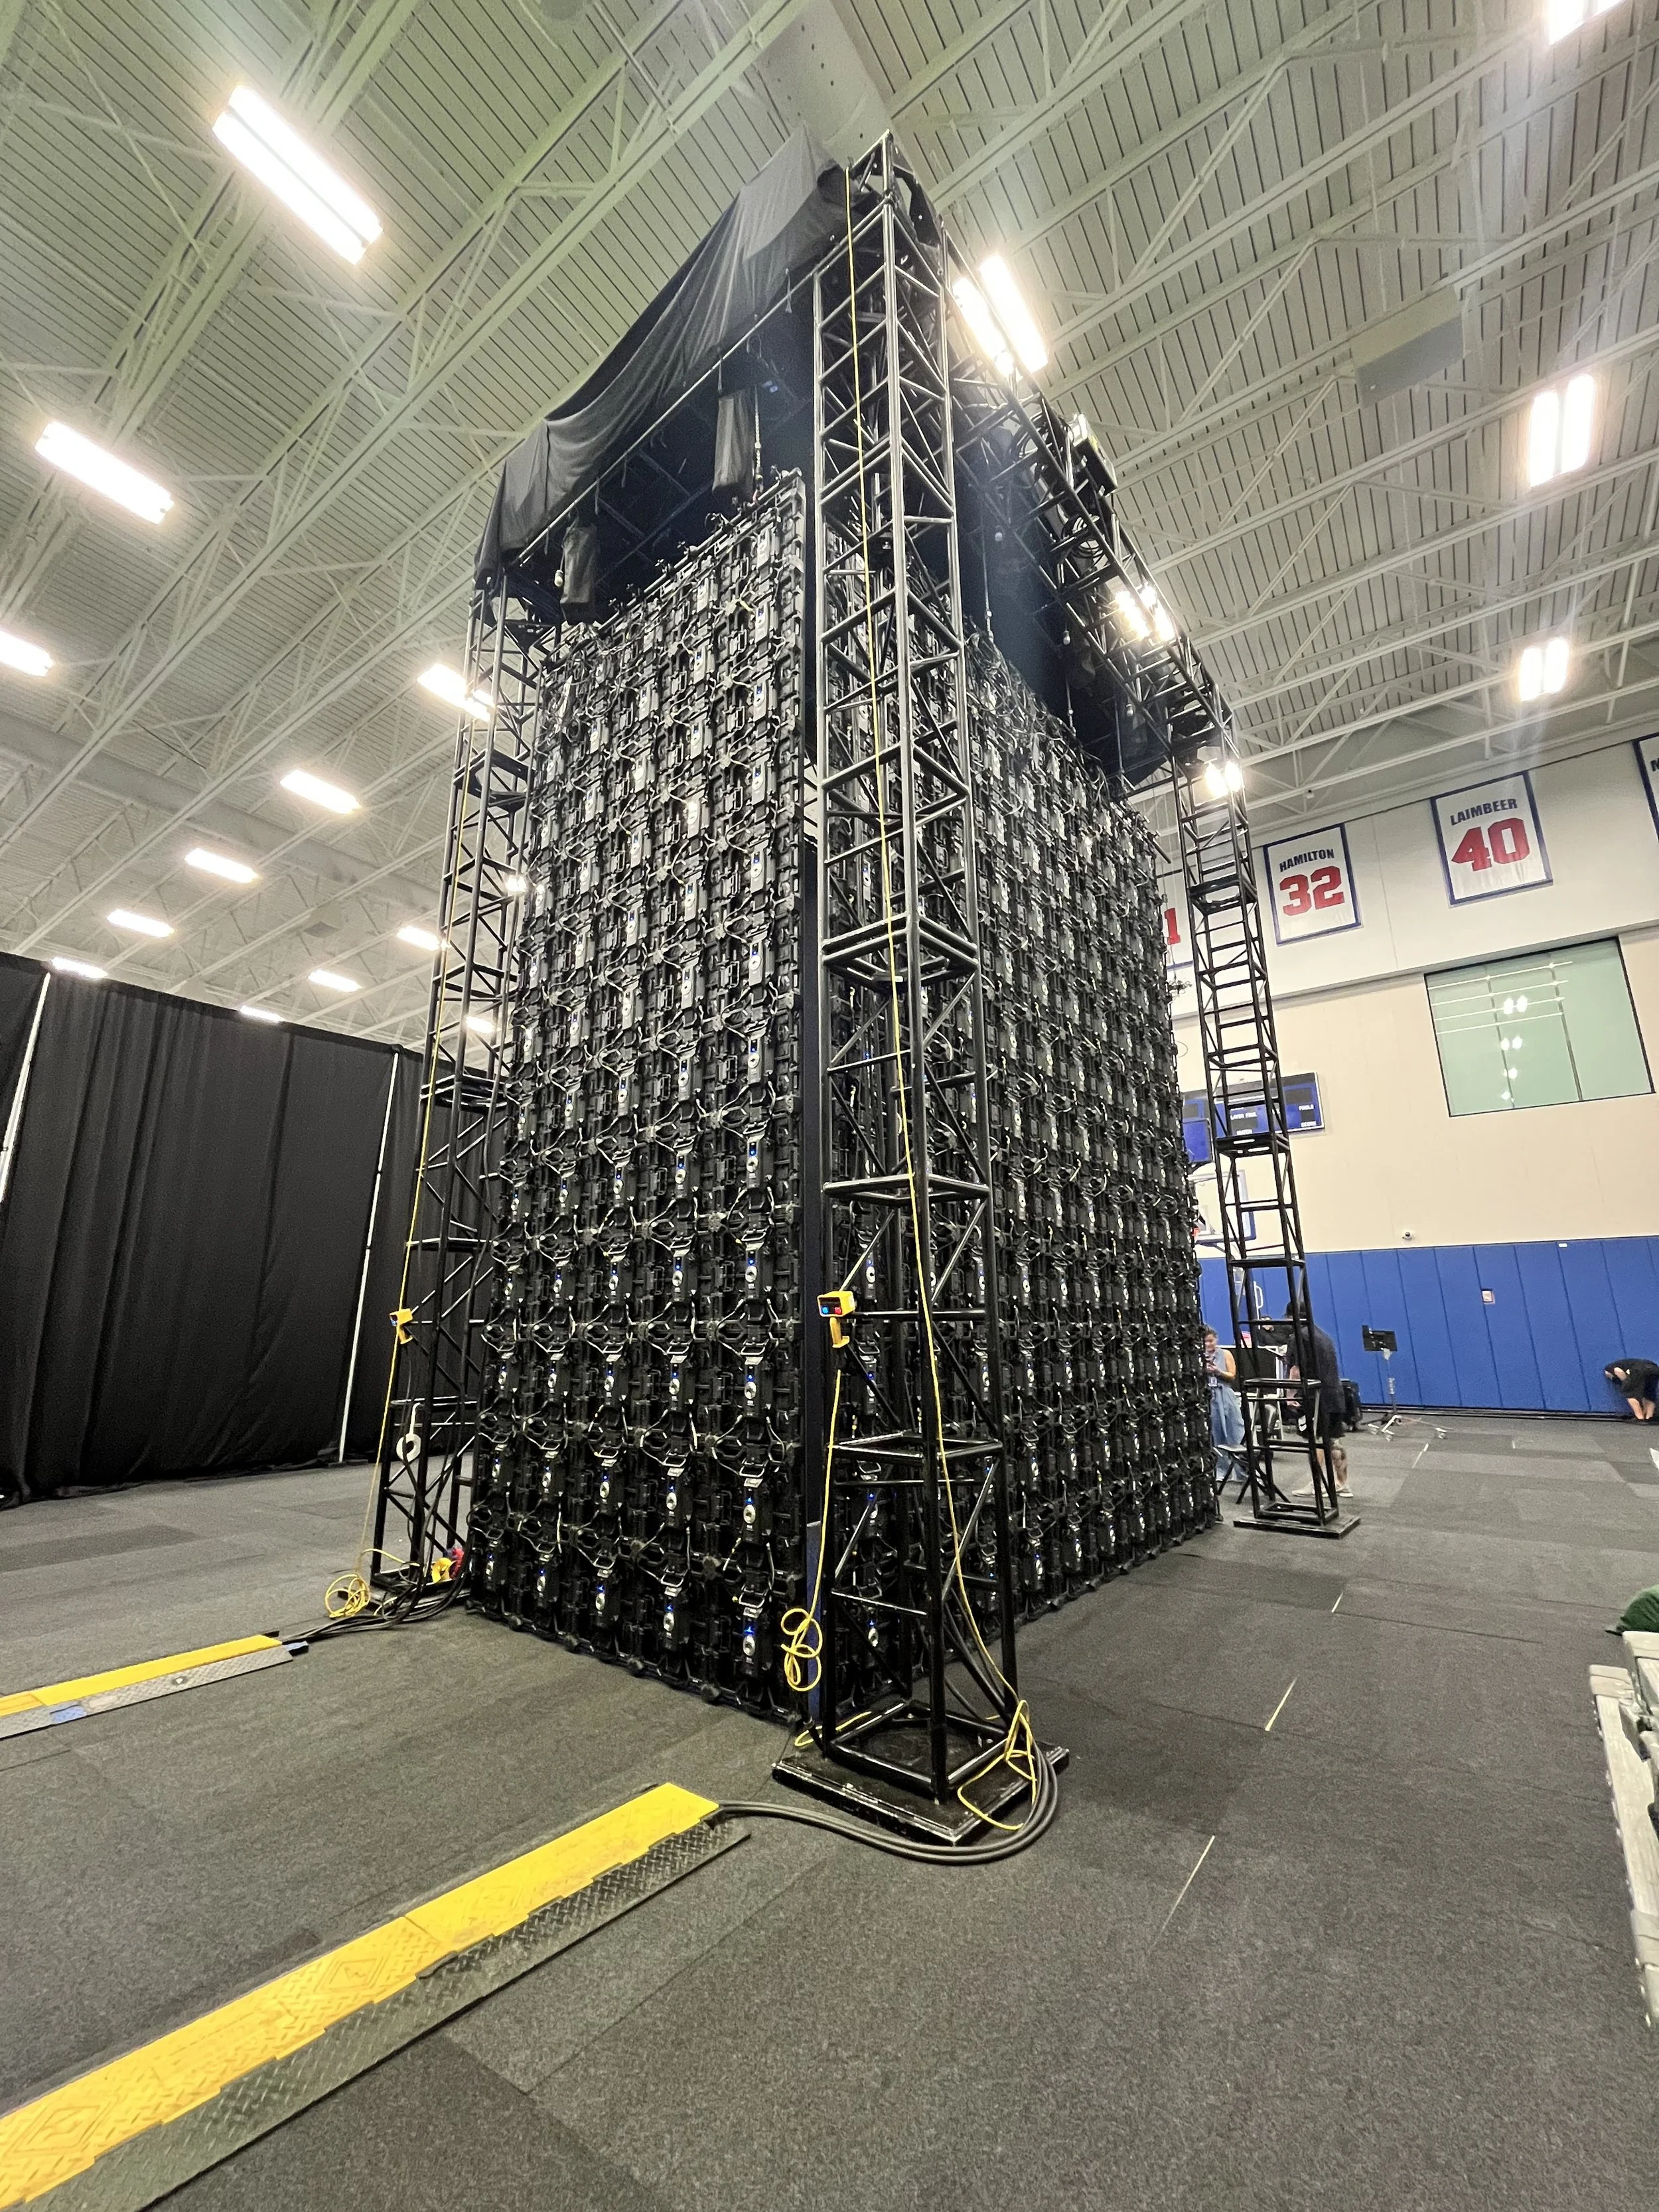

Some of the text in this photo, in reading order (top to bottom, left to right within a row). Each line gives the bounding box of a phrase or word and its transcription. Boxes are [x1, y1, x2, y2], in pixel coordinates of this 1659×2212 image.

[1450, 798, 1518, 826] LAIMBEER
[1279, 849, 1334, 872] HAMILTON
[1451, 818, 1530, 871] 40
[1279, 865, 1344, 916] 32
